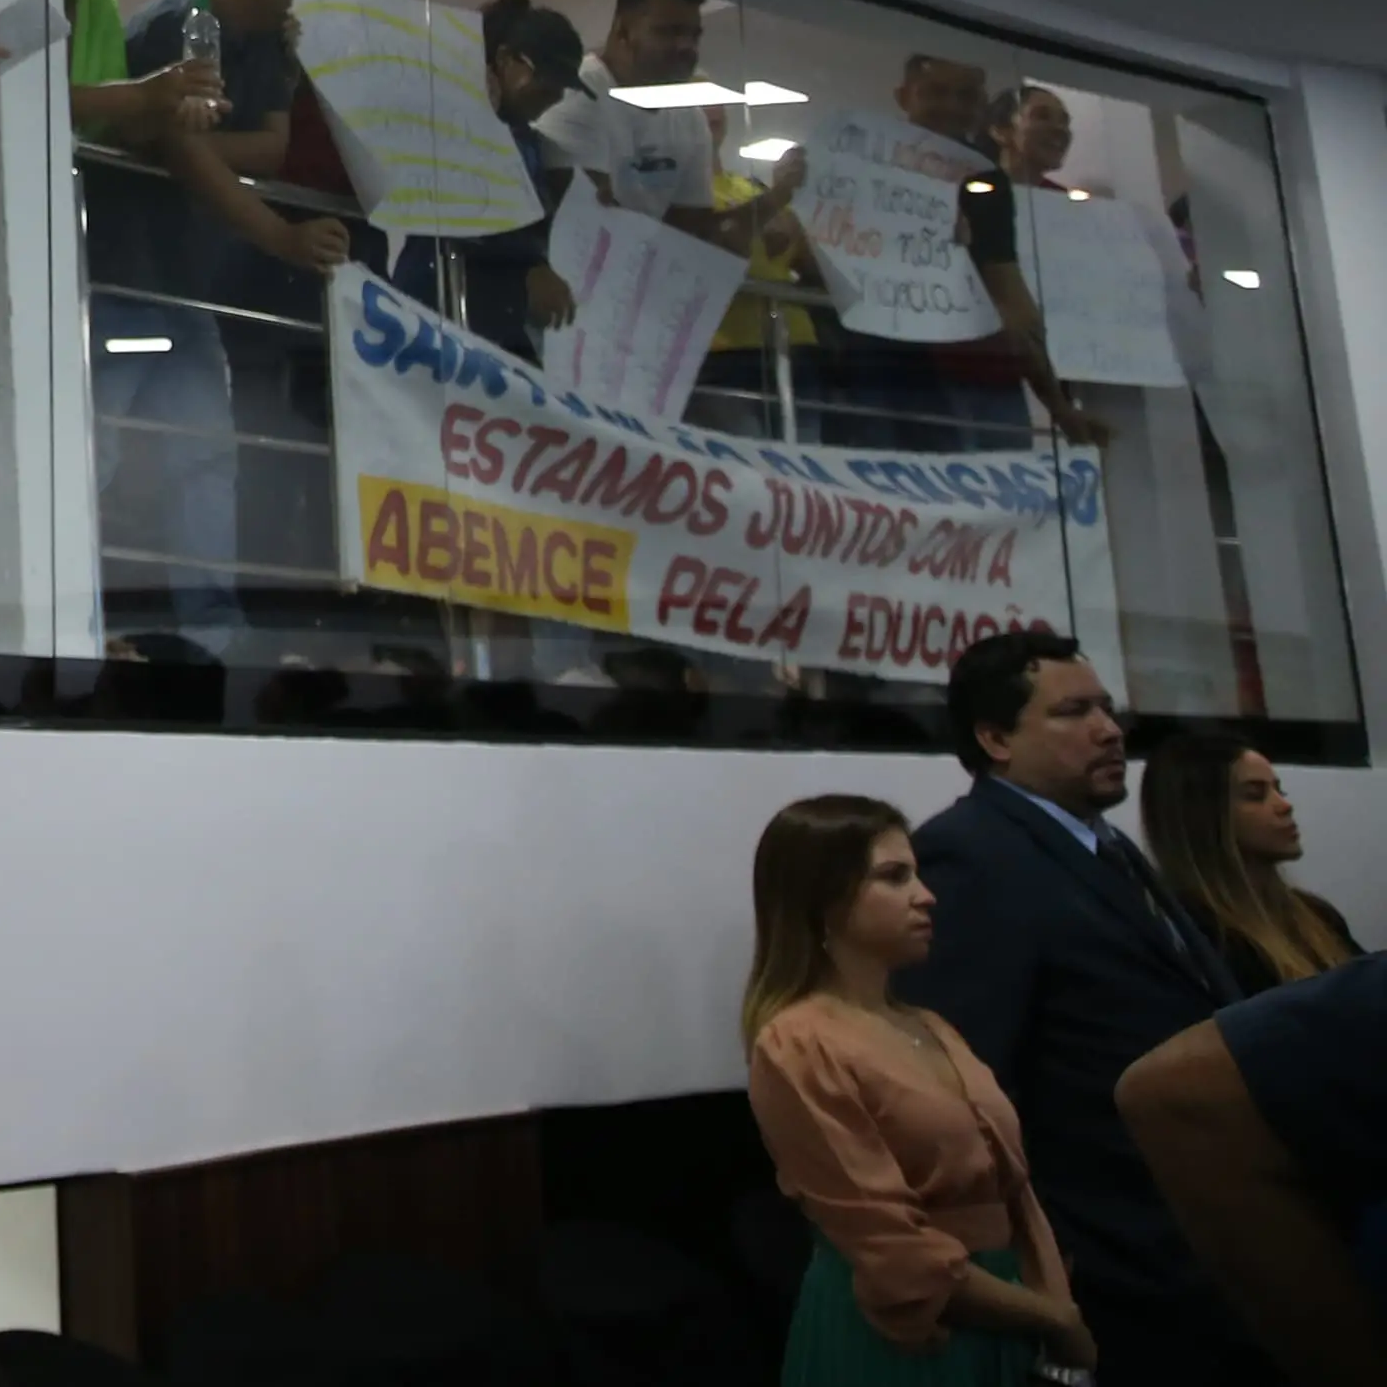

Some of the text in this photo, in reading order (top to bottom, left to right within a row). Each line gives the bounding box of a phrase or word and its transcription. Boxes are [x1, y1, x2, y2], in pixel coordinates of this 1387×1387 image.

[365, 487, 619, 614] ABEMCE
[656, 554, 812, 651] PELA
[439, 403, 733, 538] ESTAMOS
[745, 476, 919, 567] JUNTOS
[907, 517, 990, 584] COM
[986, 528, 1019, 589] A
